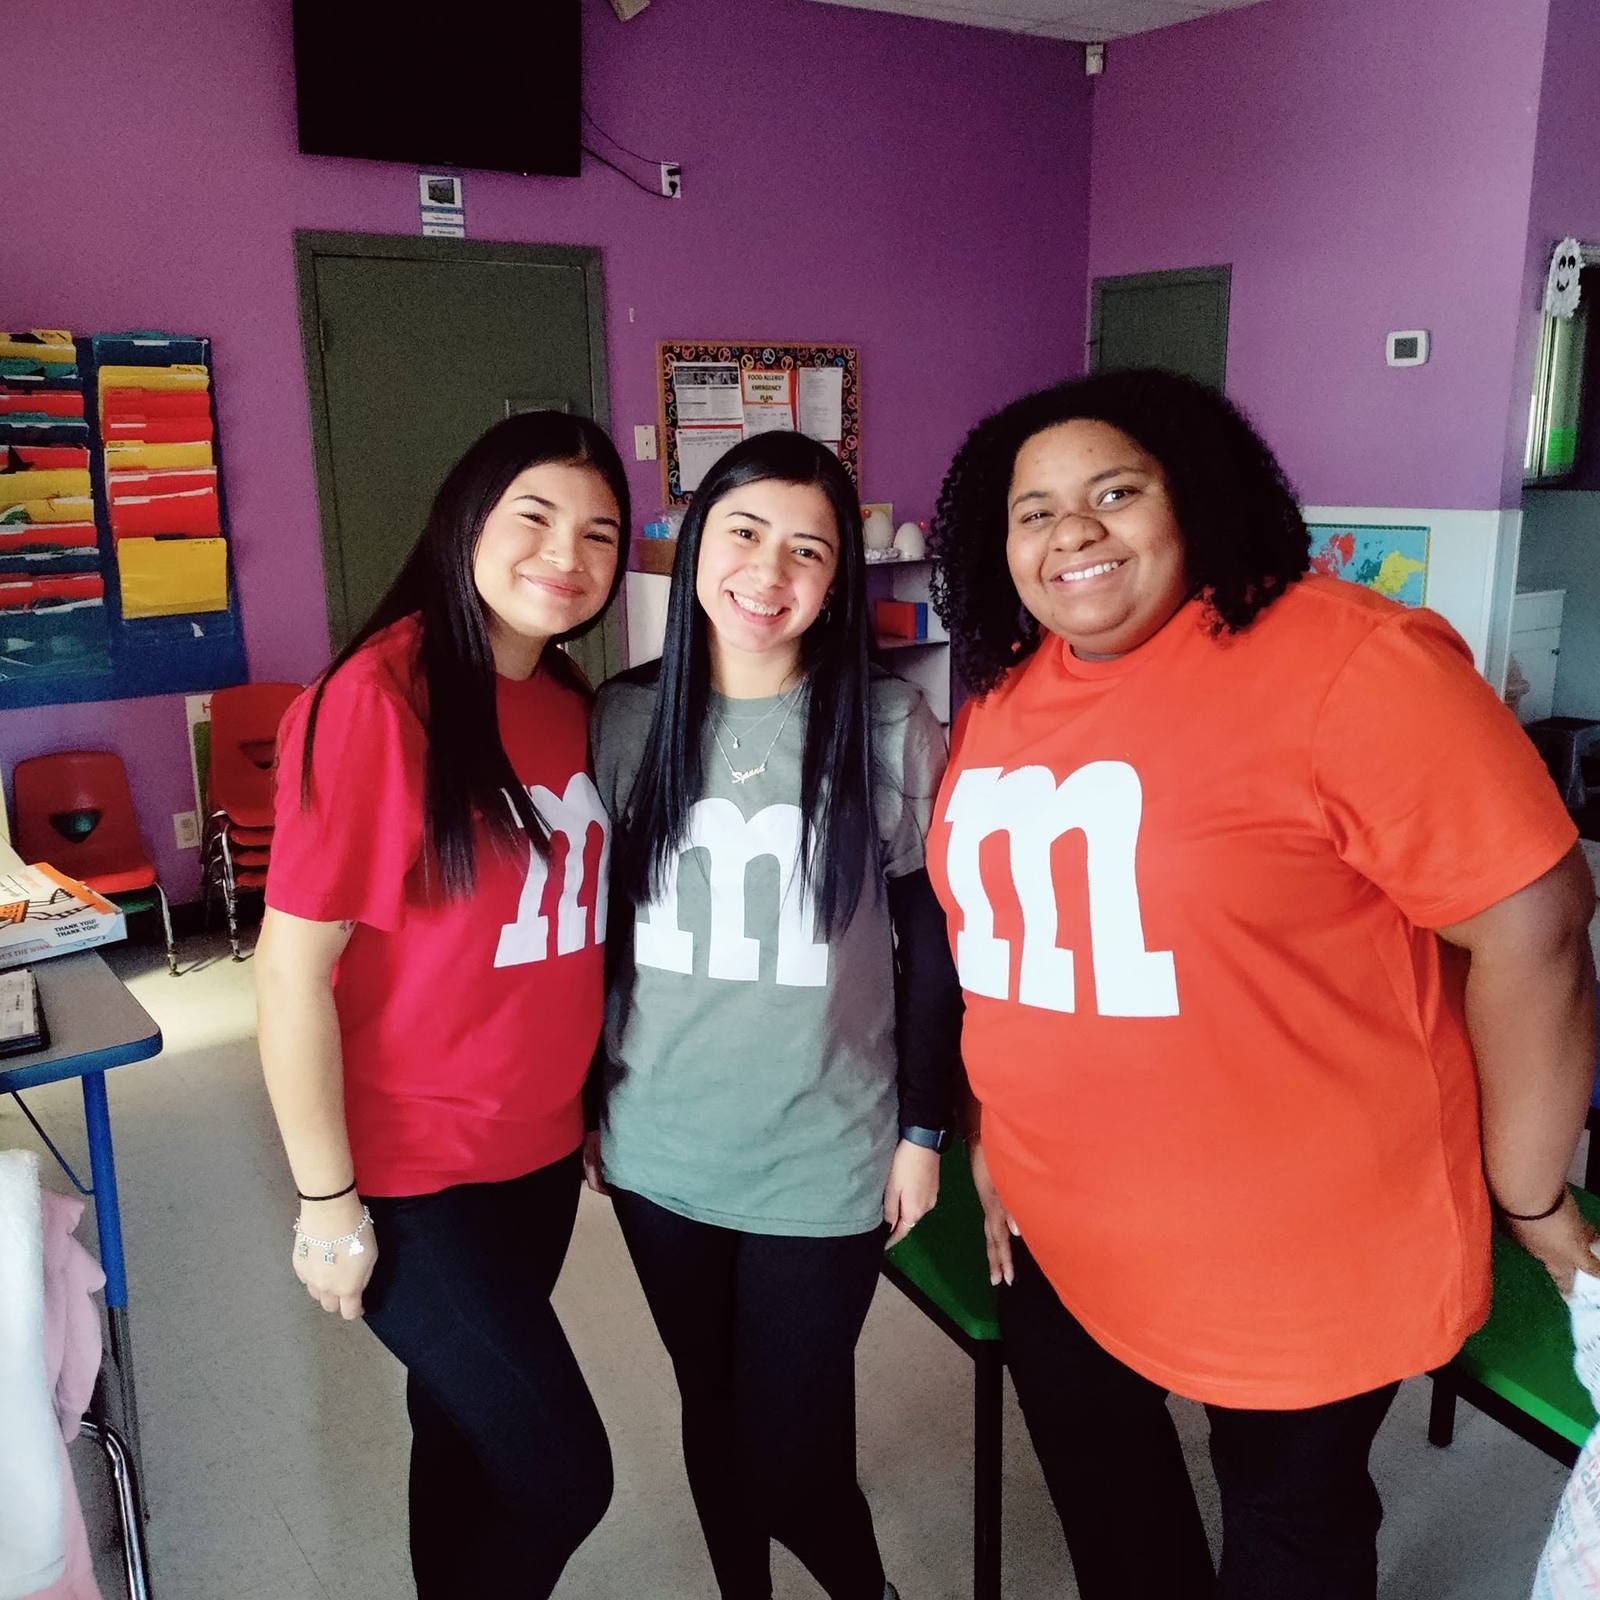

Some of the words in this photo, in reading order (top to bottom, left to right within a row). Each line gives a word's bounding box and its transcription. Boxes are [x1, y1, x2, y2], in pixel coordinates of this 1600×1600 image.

[943, 760, 1180, 1017] m
[54, 922, 79, 933] THANK
[56, 928, 81, 938] THANK
